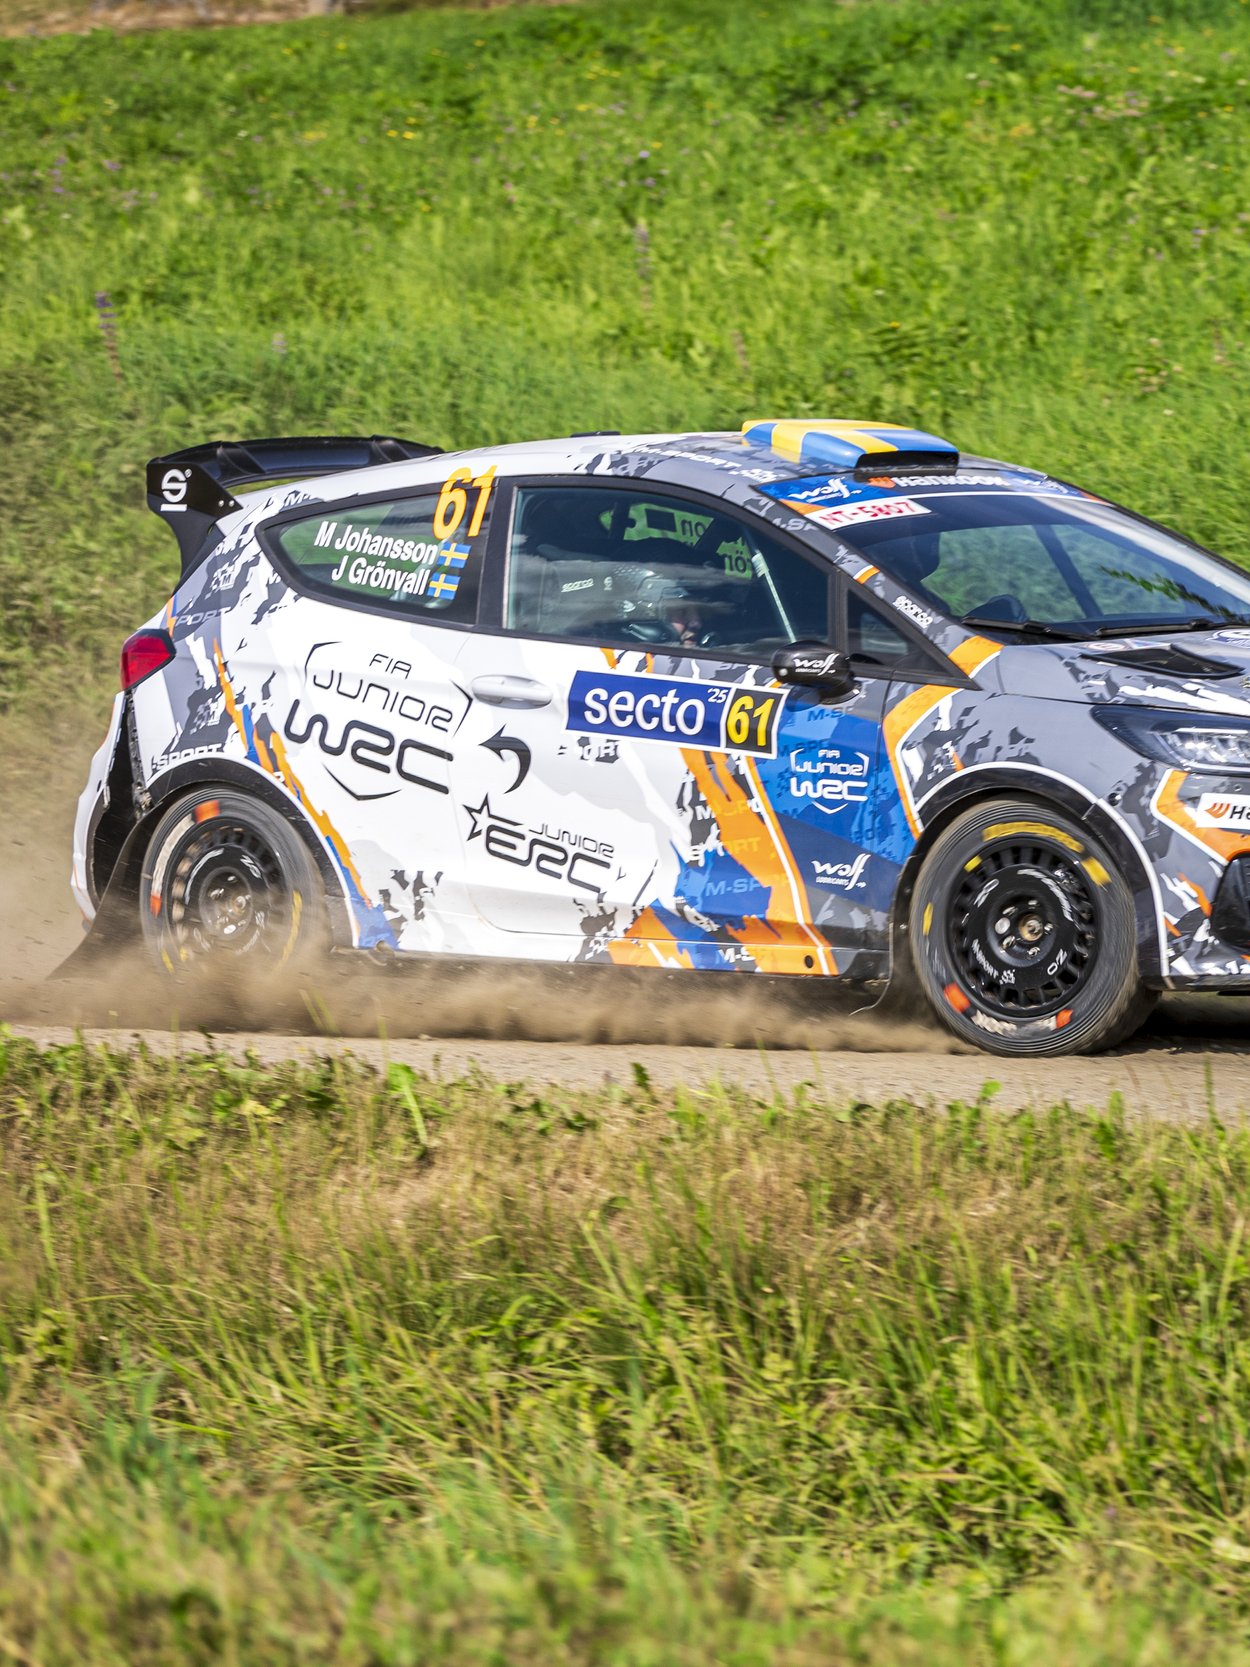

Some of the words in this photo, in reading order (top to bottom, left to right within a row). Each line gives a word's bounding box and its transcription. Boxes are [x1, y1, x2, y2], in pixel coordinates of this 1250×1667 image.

[433, 464, 498, 540] 61
[314, 521, 338, 547] M
[335, 525, 439, 565] Johansson
[331, 555, 349, 581] J
[348, 557, 431, 596] Grönvall
[369, 653, 412, 680] FIA
[793, 653, 840, 676] wolf
[313, 669, 453, 732] JUNIOR
[584, 688, 706, 736] secto
[726, 695, 775, 748] 61
[284, 698, 454, 795] WRC
[818, 749, 840, 759] FIA
[790, 777, 868, 802] WRC
[795, 761, 864, 777] JUNIOR
[485, 824, 612, 894] ERC
[528, 823, 615, 859] JUNIOR
[811, 853, 872, 891] wolf
